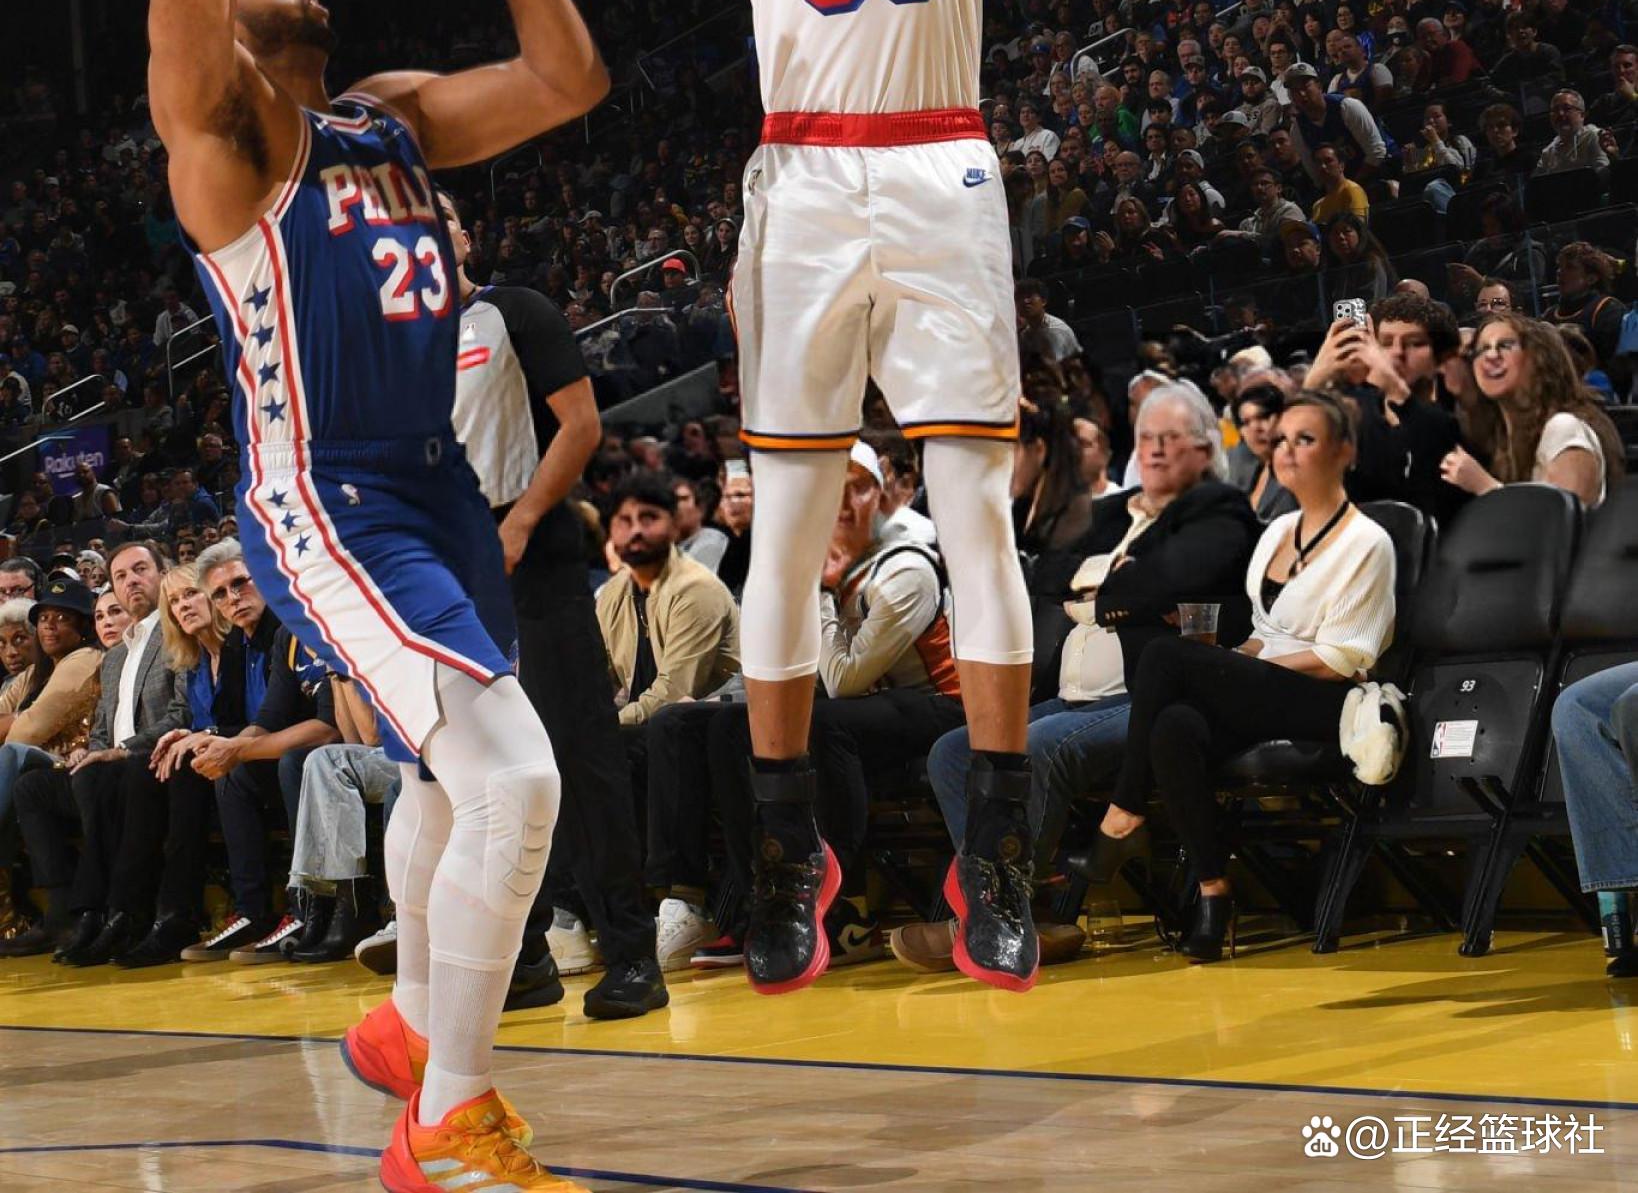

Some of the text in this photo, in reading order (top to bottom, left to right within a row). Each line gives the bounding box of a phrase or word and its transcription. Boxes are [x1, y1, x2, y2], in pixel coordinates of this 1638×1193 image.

[966, 167, 986, 179] NIKE
[372, 236, 452, 322] 23
[1460, 680, 1477, 692] 93
